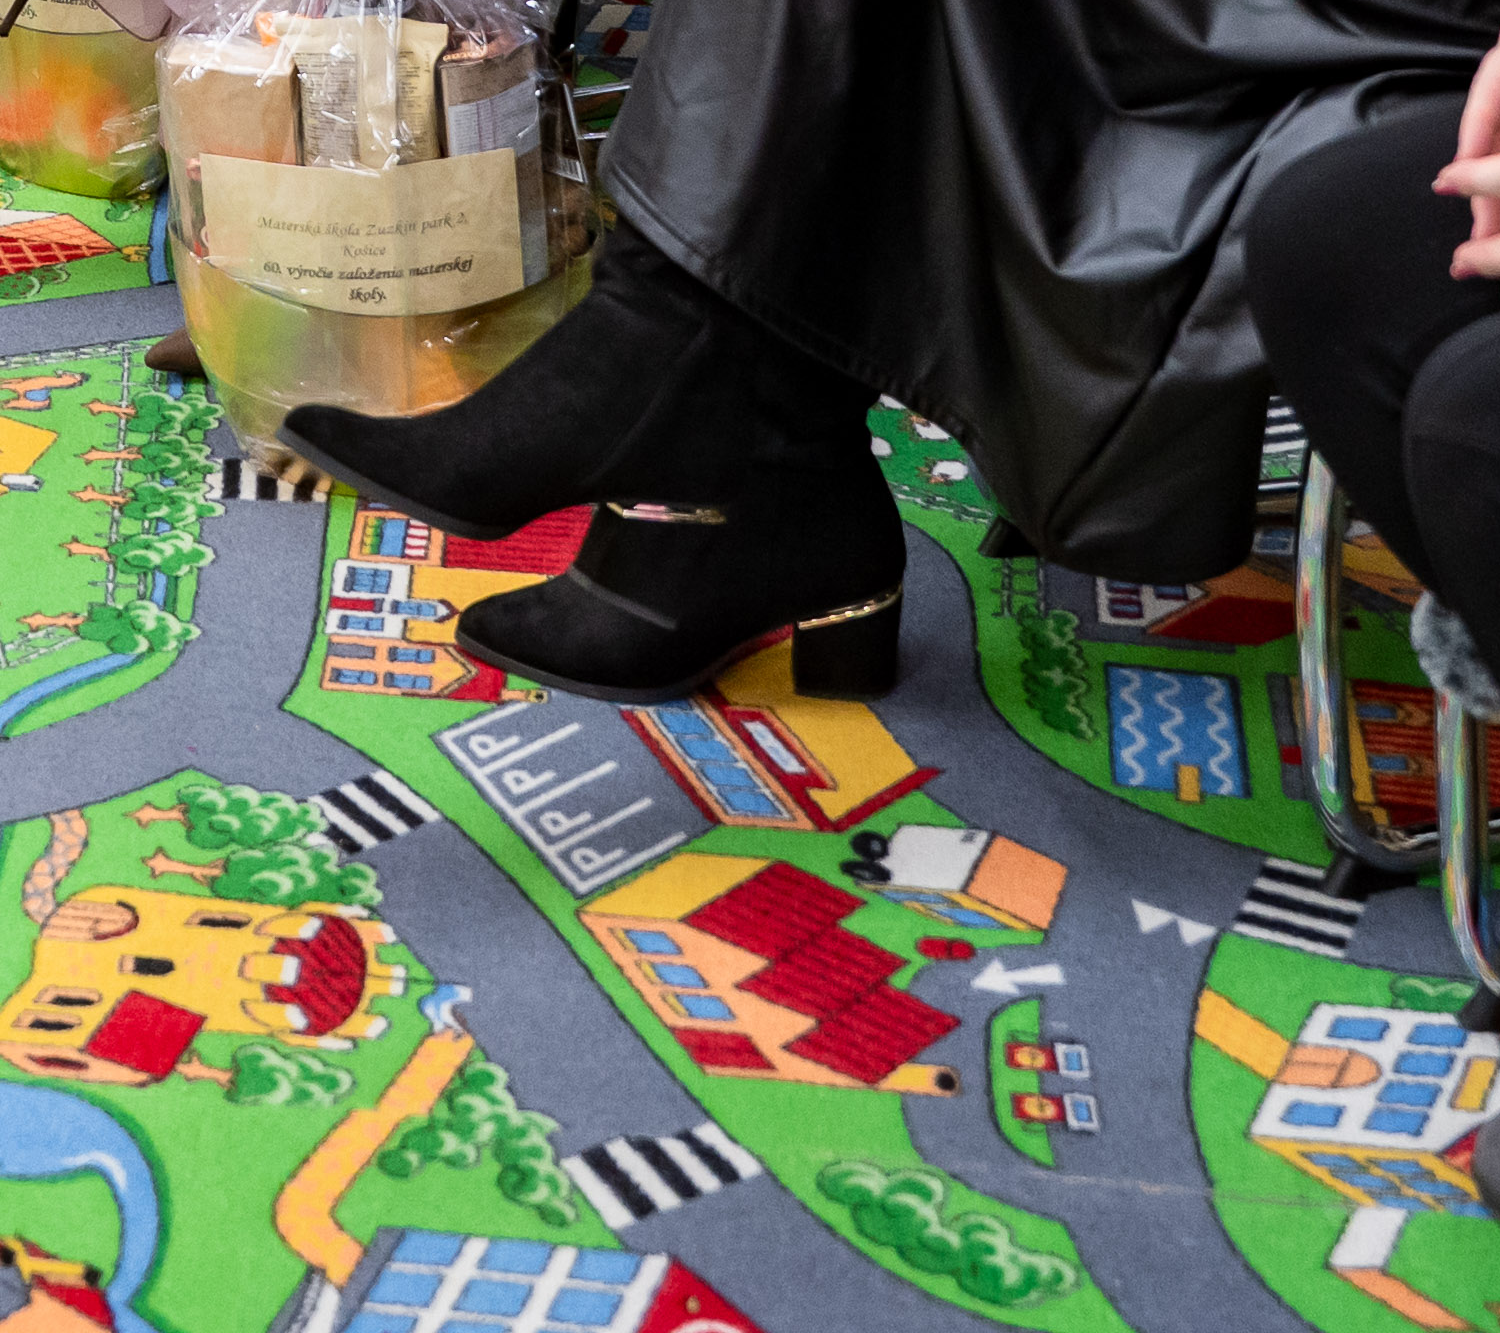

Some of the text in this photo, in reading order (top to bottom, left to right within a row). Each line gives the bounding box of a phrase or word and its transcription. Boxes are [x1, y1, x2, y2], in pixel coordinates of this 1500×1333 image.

[257, 216, 321, 237] Materská
[326, 222, 360, 238] škola
[365, 222, 416, 237] Zuzkin
[421, 215, 454, 234] park
[343, 245, 386, 258] Košice
[263, 254, 474, 280] 60. výročie založenia materskej
[348, 287, 387, 303] školy.
[469, 734, 521, 759] P
[502, 769, 558, 795] P
[539, 810, 592, 837] P
[570, 847, 626, 873] P
